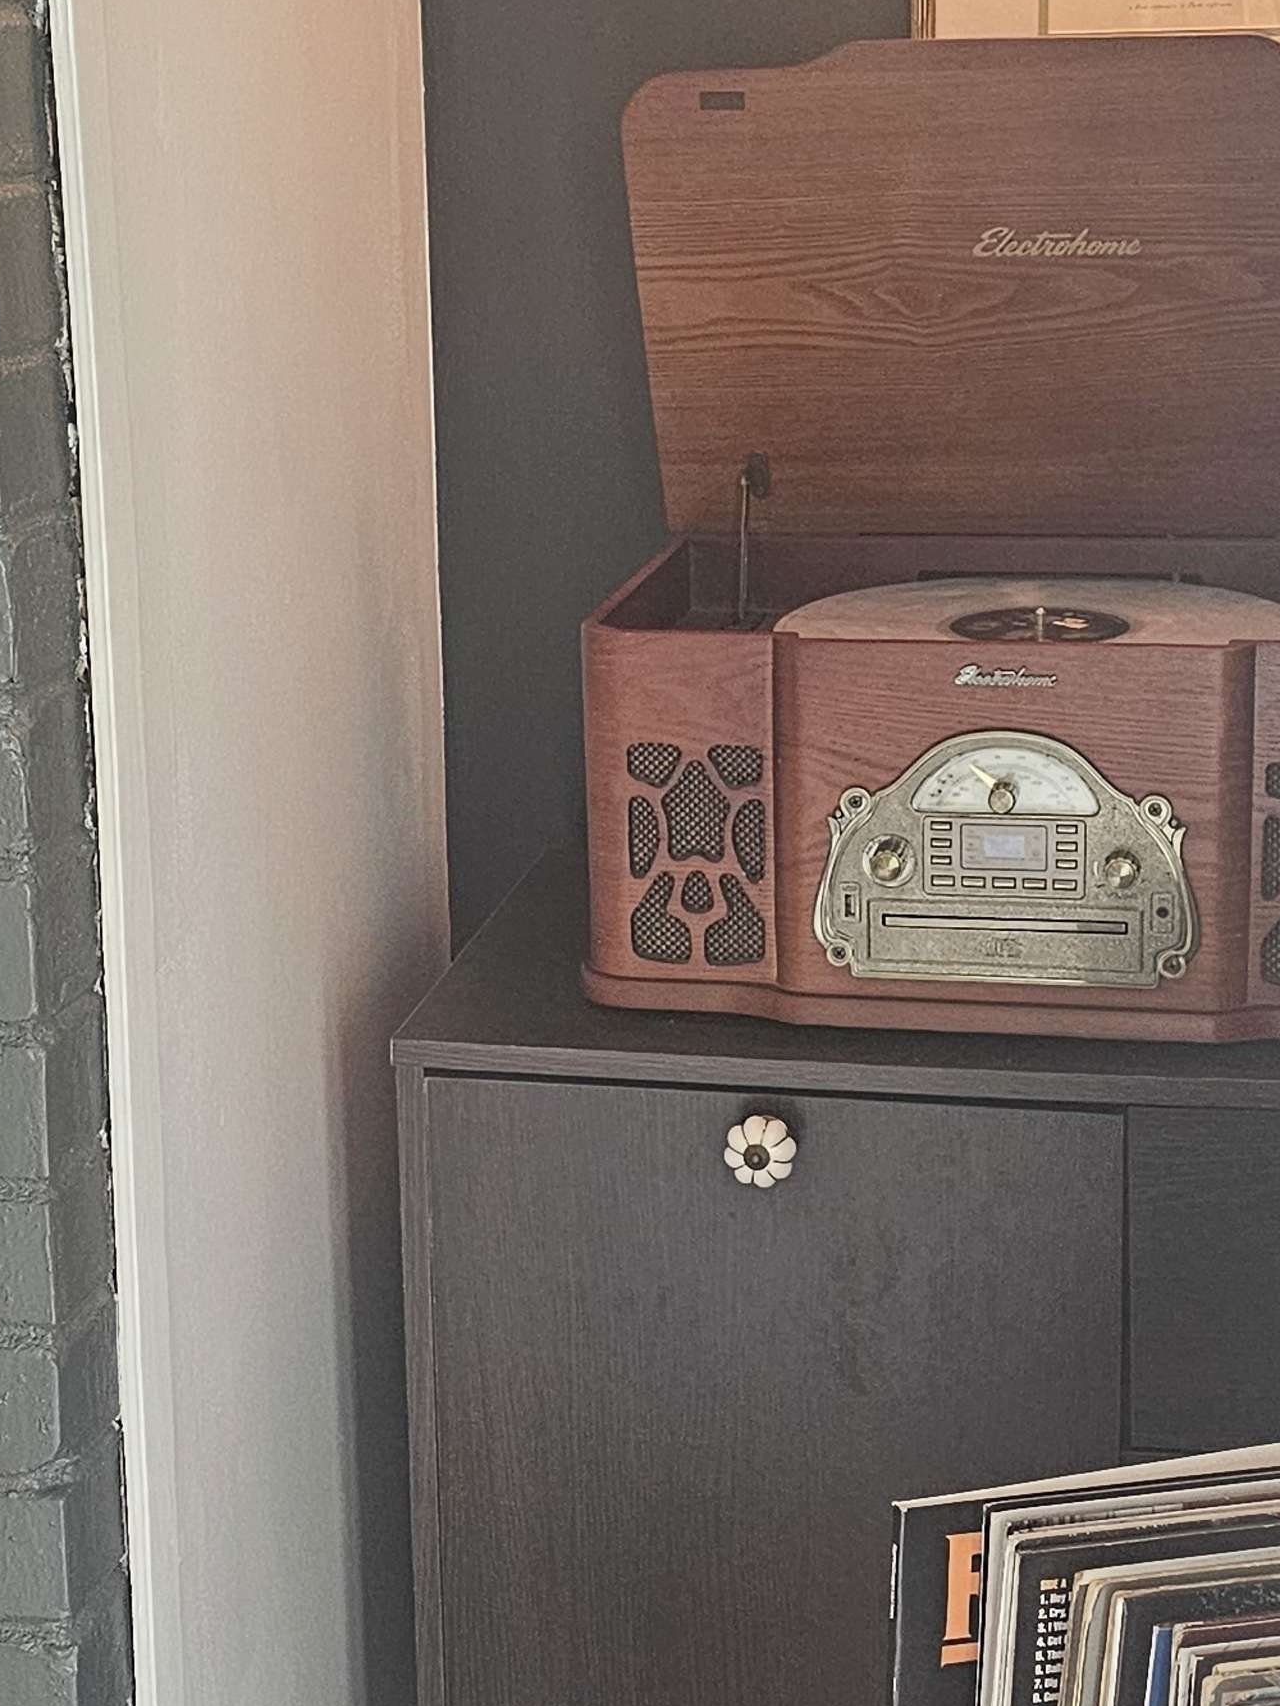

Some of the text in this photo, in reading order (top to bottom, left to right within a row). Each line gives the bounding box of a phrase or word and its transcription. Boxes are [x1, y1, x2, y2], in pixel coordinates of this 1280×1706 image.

[972, 226, 1142, 257] Electrohome
[1039, 1593, 1048, 1605] 1.
[1037, 1608, 1048, 1619] 2.
